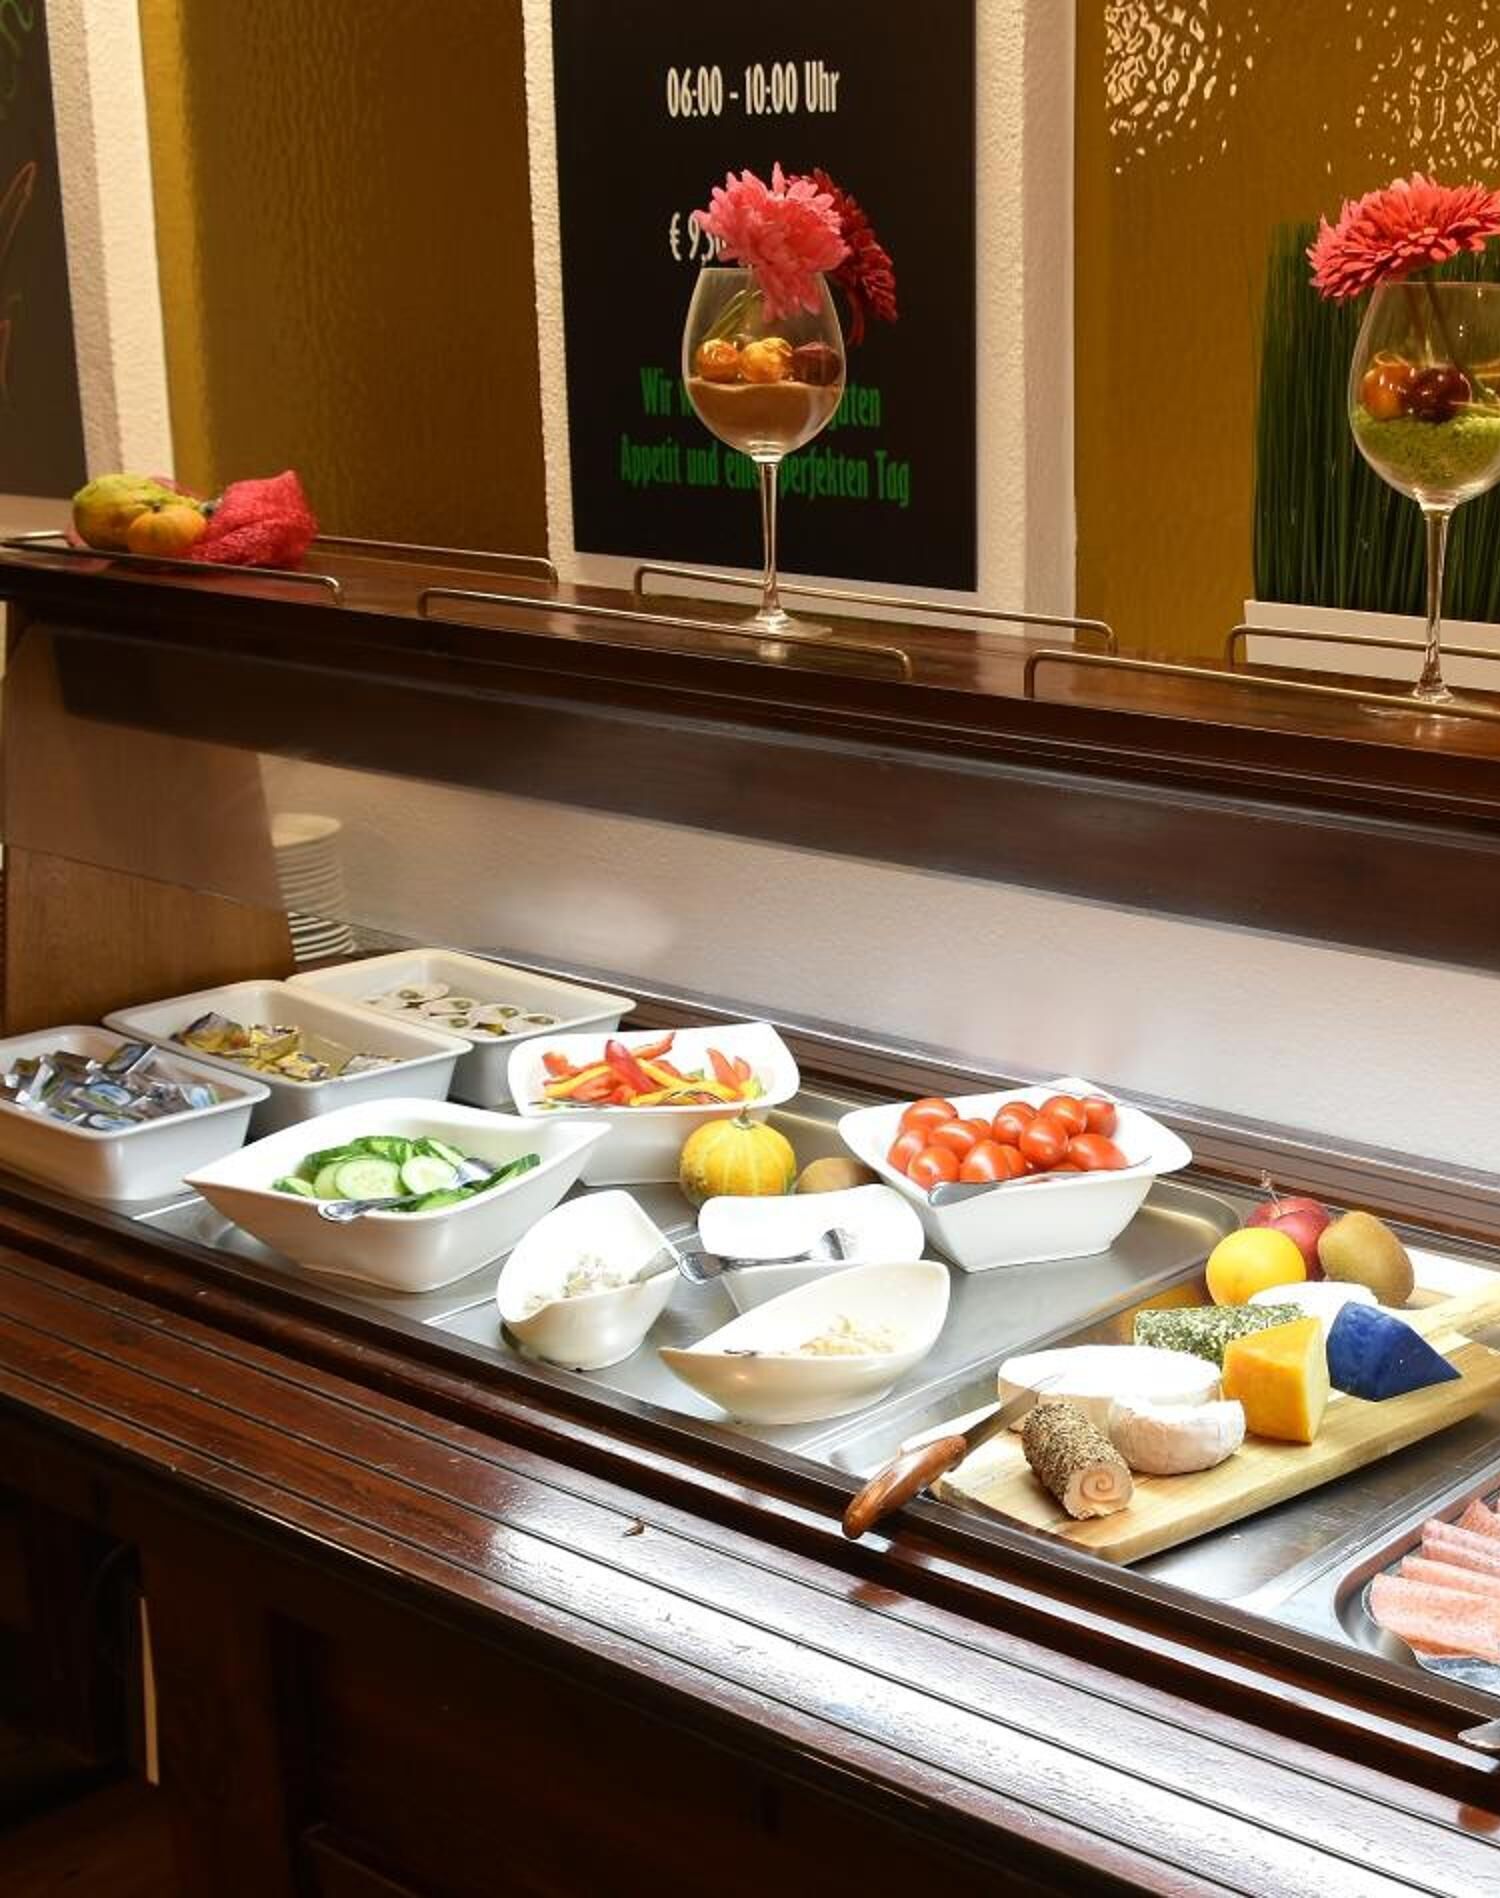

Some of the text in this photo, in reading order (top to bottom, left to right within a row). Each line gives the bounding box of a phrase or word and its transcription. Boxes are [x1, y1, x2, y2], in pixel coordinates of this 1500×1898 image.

[667, 66, 723, 117] 06:00
[745, 62, 798, 114] 10:00
[805, 61, 839, 112] Uhr
[669, 212, 681, 261] €
[641, 367, 672, 417] Wir
[621, 434, 681, 488] Appetit
[687, 440, 718, 486] und
[875, 450, 909, 507] Tag
